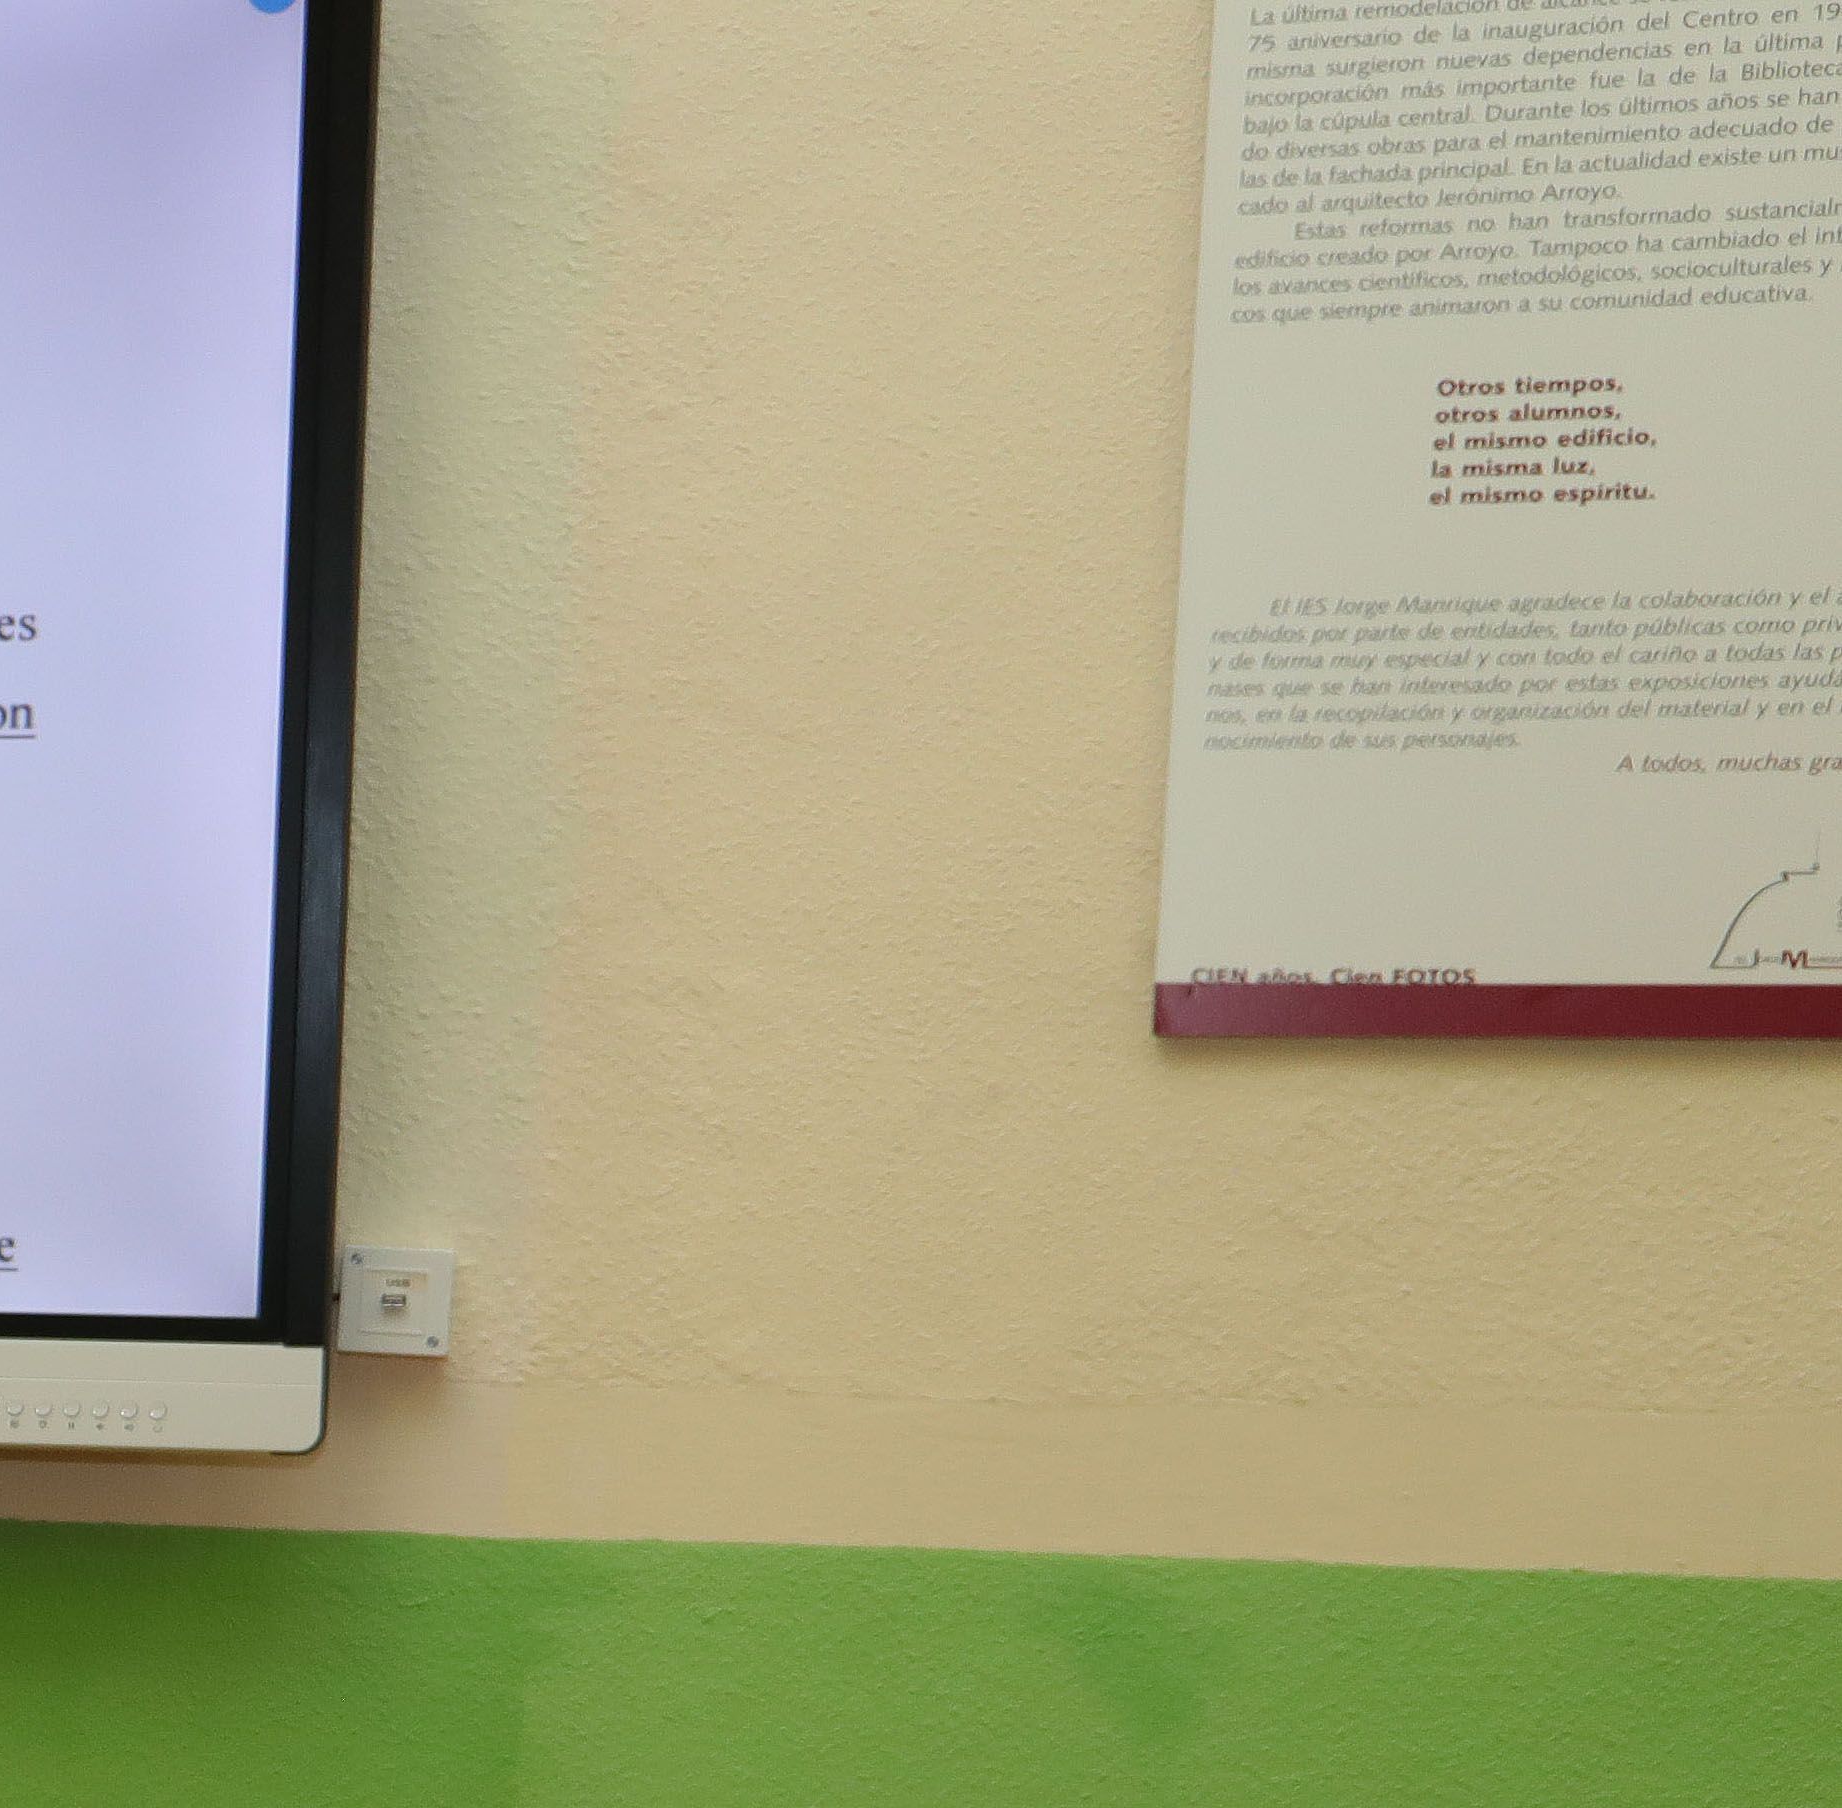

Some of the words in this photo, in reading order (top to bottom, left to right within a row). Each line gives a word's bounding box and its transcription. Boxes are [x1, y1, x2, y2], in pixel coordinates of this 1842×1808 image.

[1413, 25, 1441, 44] de
[1452, 21, 1471, 41] la
[1636, 12, 1669, 30] del
[1682, 8, 1758, 28] Centro
[1771, 8, 1798, 23] en
[1436, 377, 1506, 397] Otros
[1435, 406, 1499, 424] otros
[1433, 432, 1455, 450] el
[1465, 432, 1547, 450] mismo
[1431, 460, 1453, 479] la
[1462, 459, 1545, 477] misma
[1429, 486, 1451, 505] el
[1460, 486, 1545, 505] mismo
[1616, 753, 1634, 773] A
[1718, 750, 1803, 772] muchas
[1393, 967, 1477, 985] FOTOS
